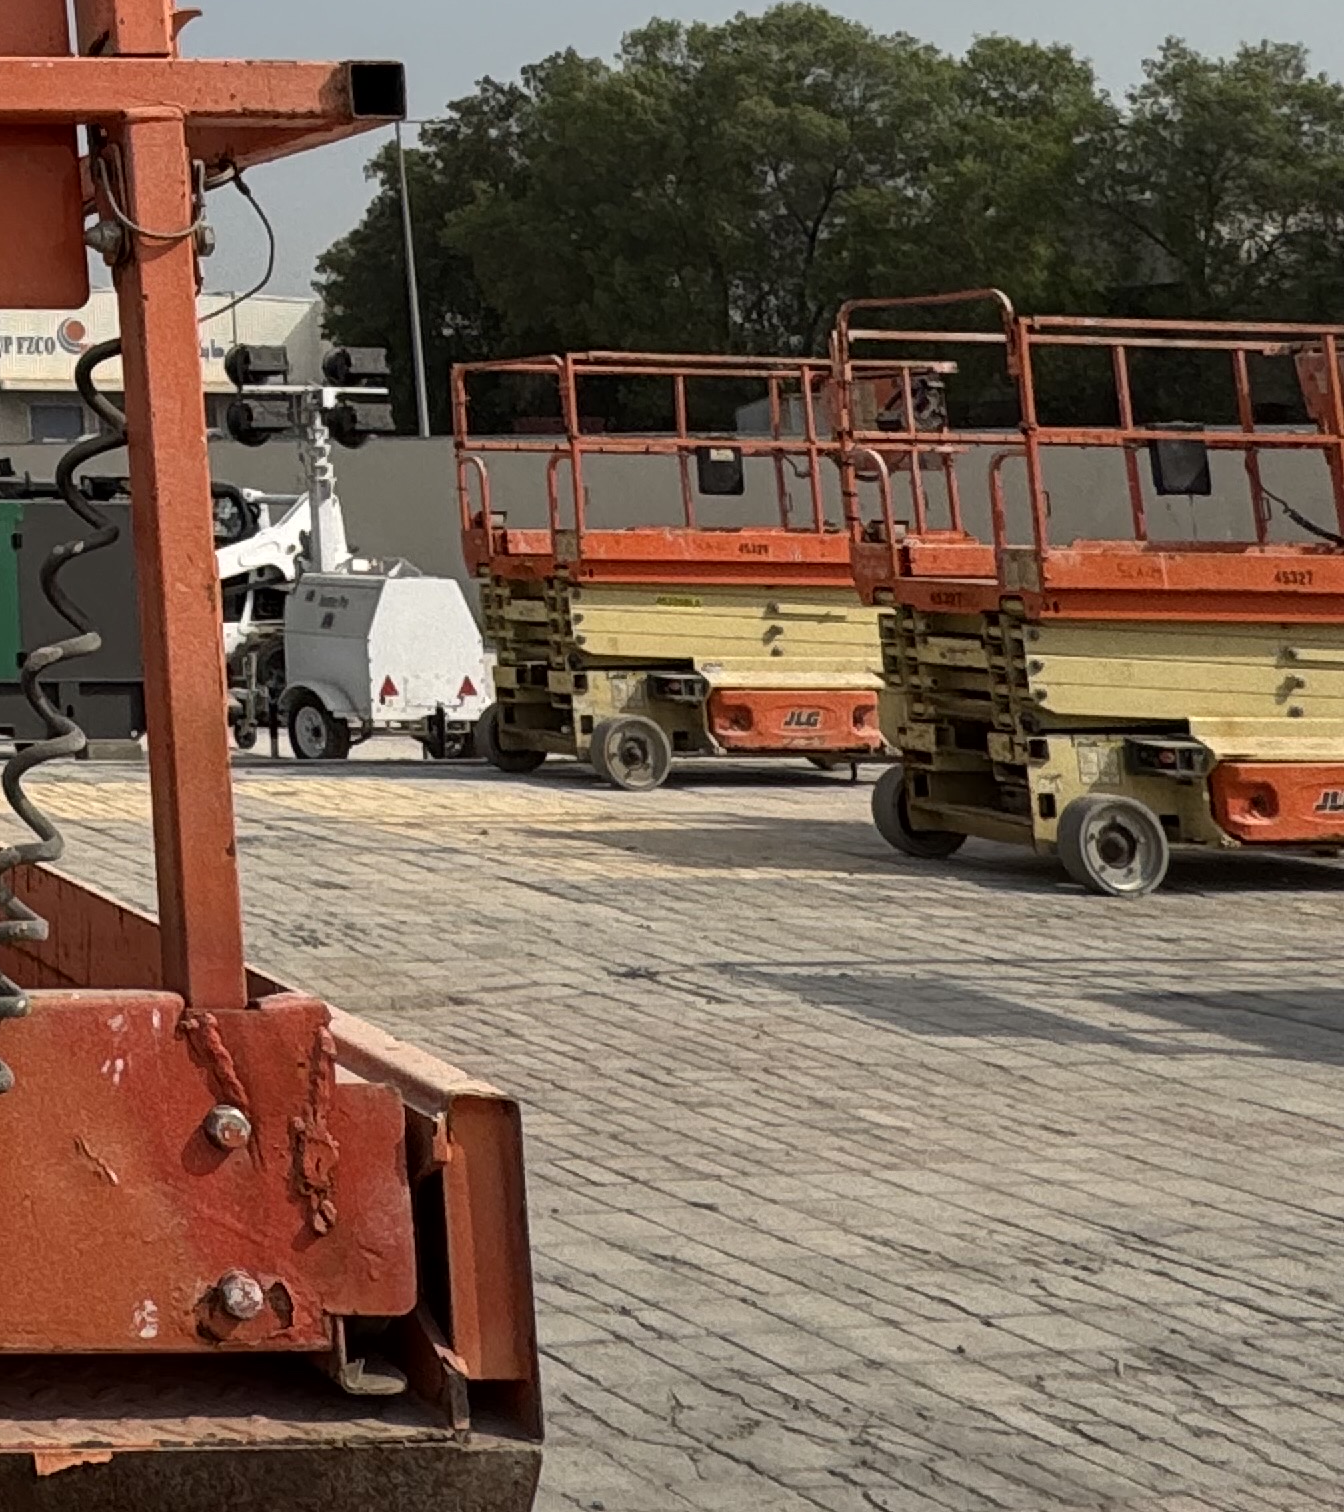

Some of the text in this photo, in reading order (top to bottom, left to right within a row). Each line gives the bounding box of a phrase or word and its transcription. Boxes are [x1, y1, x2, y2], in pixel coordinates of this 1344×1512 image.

[15, 336, 56, 356] FZCO
[1273, 569, 1313, 586] 45327
[782, 709, 822, 729] JLG
[1314, 790, 1344, 813] JL
